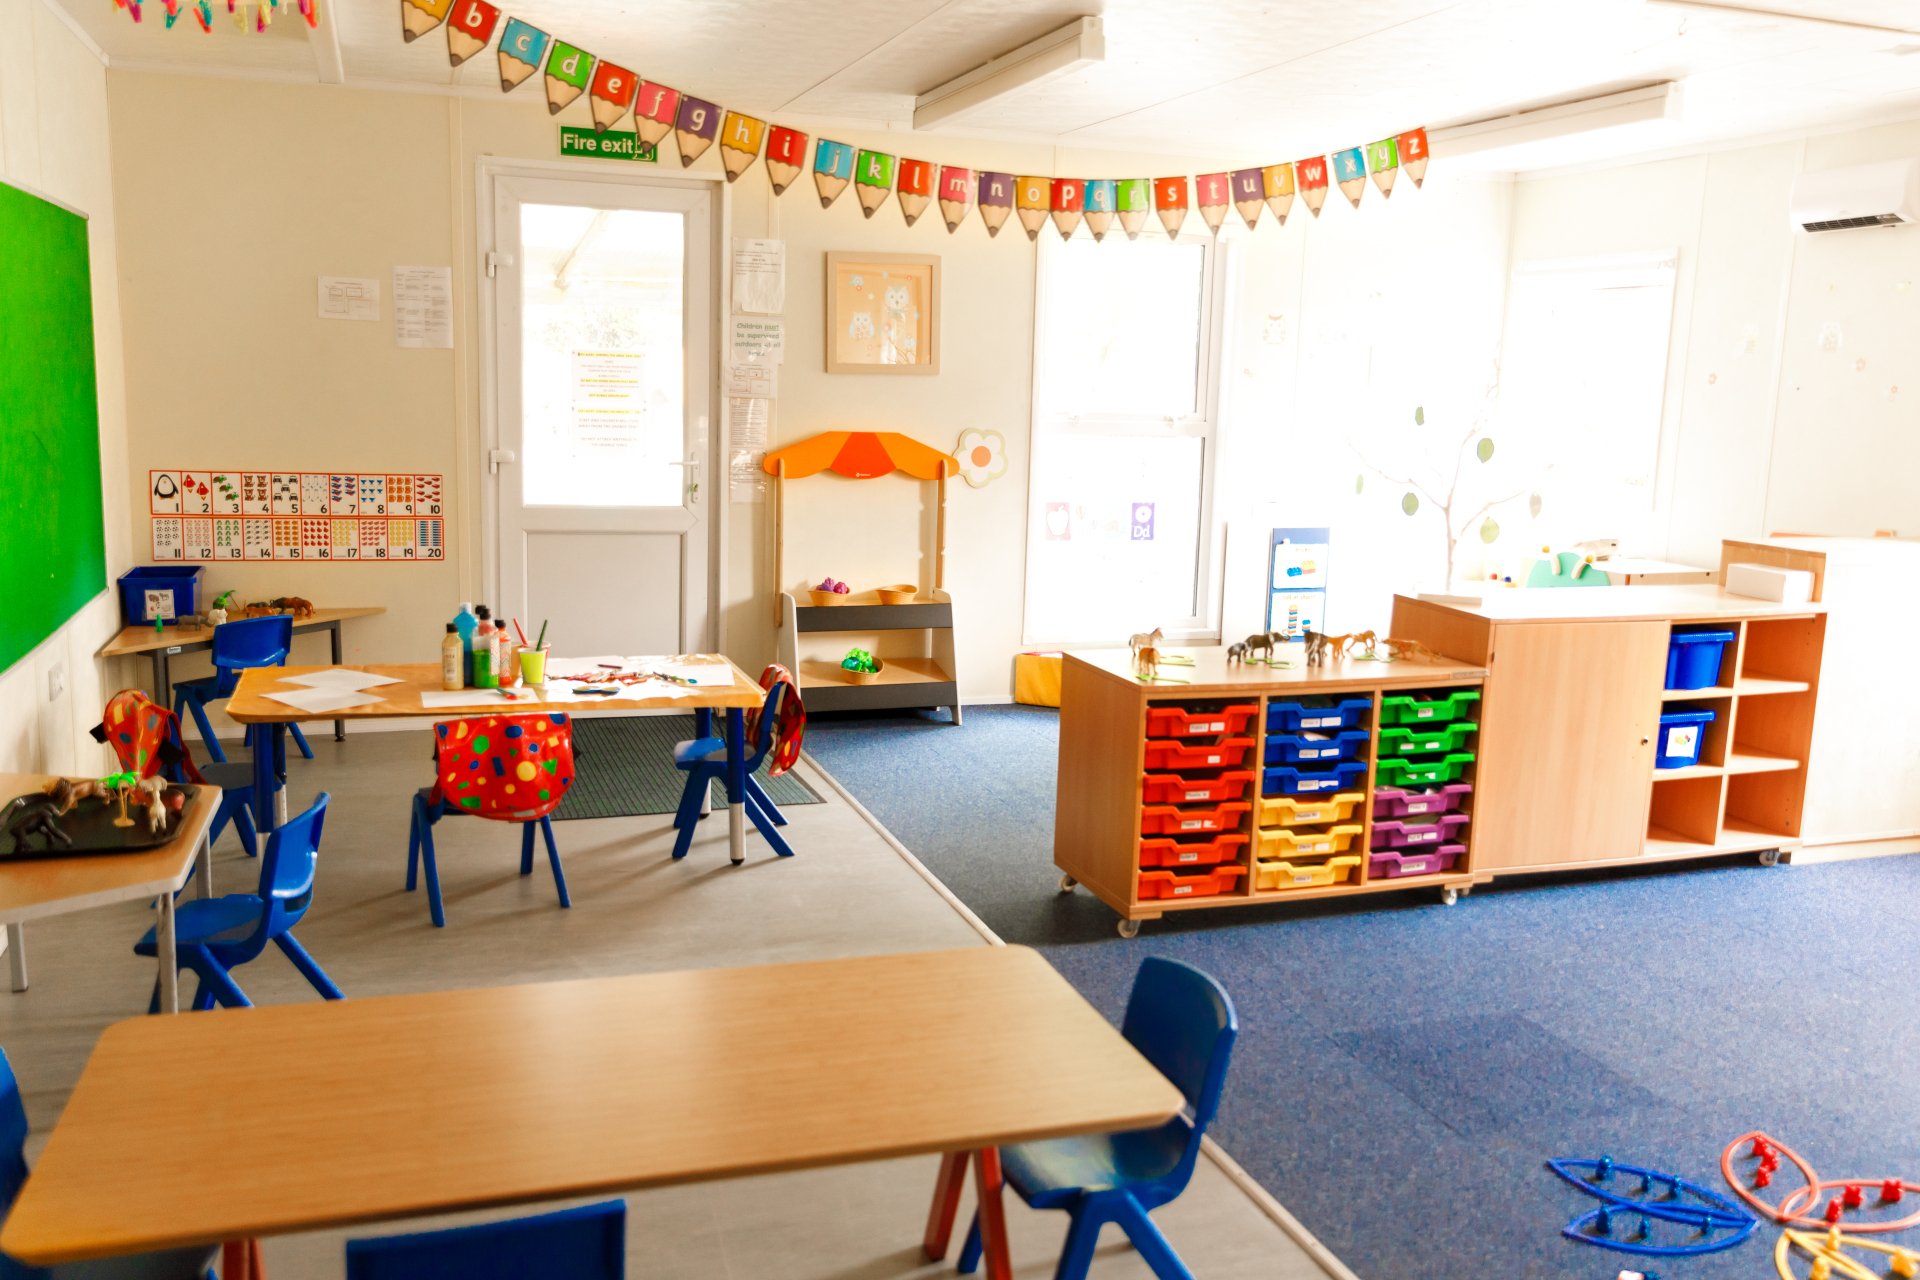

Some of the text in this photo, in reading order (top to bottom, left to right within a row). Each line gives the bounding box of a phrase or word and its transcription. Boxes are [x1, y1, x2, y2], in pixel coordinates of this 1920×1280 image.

[465, 2, 483, 28] b
[516, 35, 531, 52] c
[561, 53, 580, 77] d
[607, 77, 622, 94] e
[648, 91, 666, 117] f
[691, 108, 707, 132] g
[735, 119, 750, 144] h
[782, 135, 792, 158] i
[828, 150, 841, 174] j
[867, 154, 882, 180] k
[913, 166, 920, 189] l
[950, 178, 967, 193] m
[991, 182, 1003, 197] n
[1028, 188, 1040, 202] o
[1062, 185, 1075, 208] p
[1168, 187, 1178, 202] s
[1209, 181, 1219, 200] t
[1243, 178, 1257, 193] u
[1305, 166, 1322, 181] w
[1344, 158, 1357, 173] x
[1378, 146, 1390, 168] y
[1408, 137, 1421, 155] z
[563, 133, 634, 154] Fire exit
[736, 322, 763, 330] Children
[201, 503, 209, 513] 2
[232, 503, 240, 513] 3
[262, 504, 269, 513] 4
[291, 504, 299, 513] 5
[320, 504, 328, 514] 6
[349, 504, 356, 514] 7
[377, 504, 385, 514] 8
[405, 504, 412, 514] 9
[430, 505, 441, 514] 10
[1134, 525, 1151, 538] Dd
[174, 548, 442, 558] 11 12 13 14 15 16 17 18 19 20
